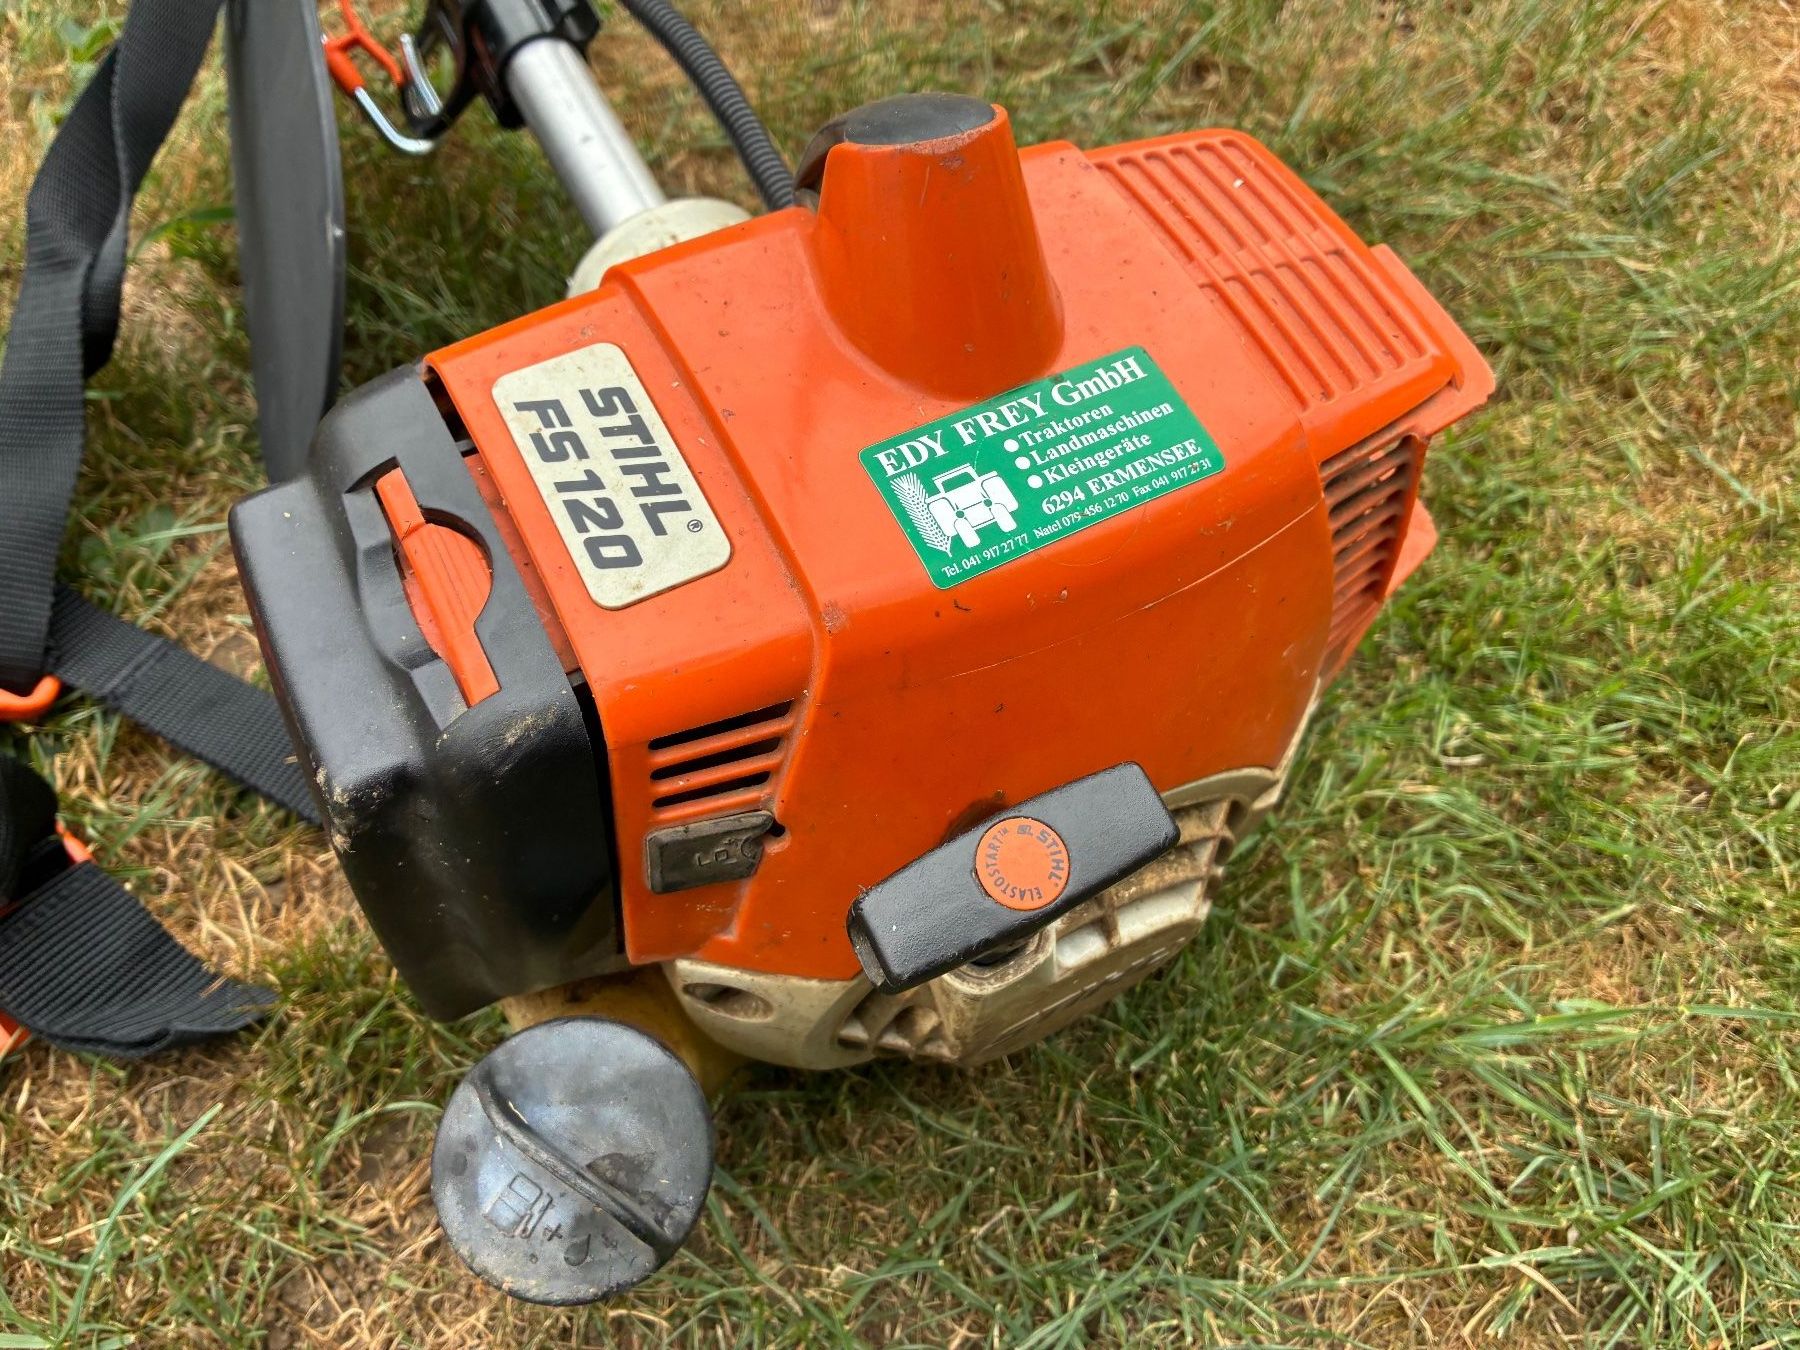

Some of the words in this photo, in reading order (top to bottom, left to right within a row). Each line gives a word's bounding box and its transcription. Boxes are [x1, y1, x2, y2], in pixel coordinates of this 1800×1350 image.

[873, 430, 950, 478] EDY
[951, 392, 1049, 447] FREY
[1051, 355, 1148, 406] GmbH
[1018, 404, 1114, 447] Traktoren
[1029, 402, 1174, 466] Landmaschinen
[1041, 485, 1086, 515] 6294
[1085, 438, 1202, 496] ERMENSEE
[1042, 433, 1152, 485] Kleingeräte
[941, 562, 963, 578] Tel.
[961, 554, 982, 570] 041
[982, 545, 1001, 561] 917
[1032, 519, 1063, 539] Natel
[1061, 511, 1082, 527] 079
[1083, 502, 1103, 517] 456
[1131, 484, 1152, 498] Fax
[1151, 474, 1170, 489] 041
[1170, 466, 1188, 481] 917
